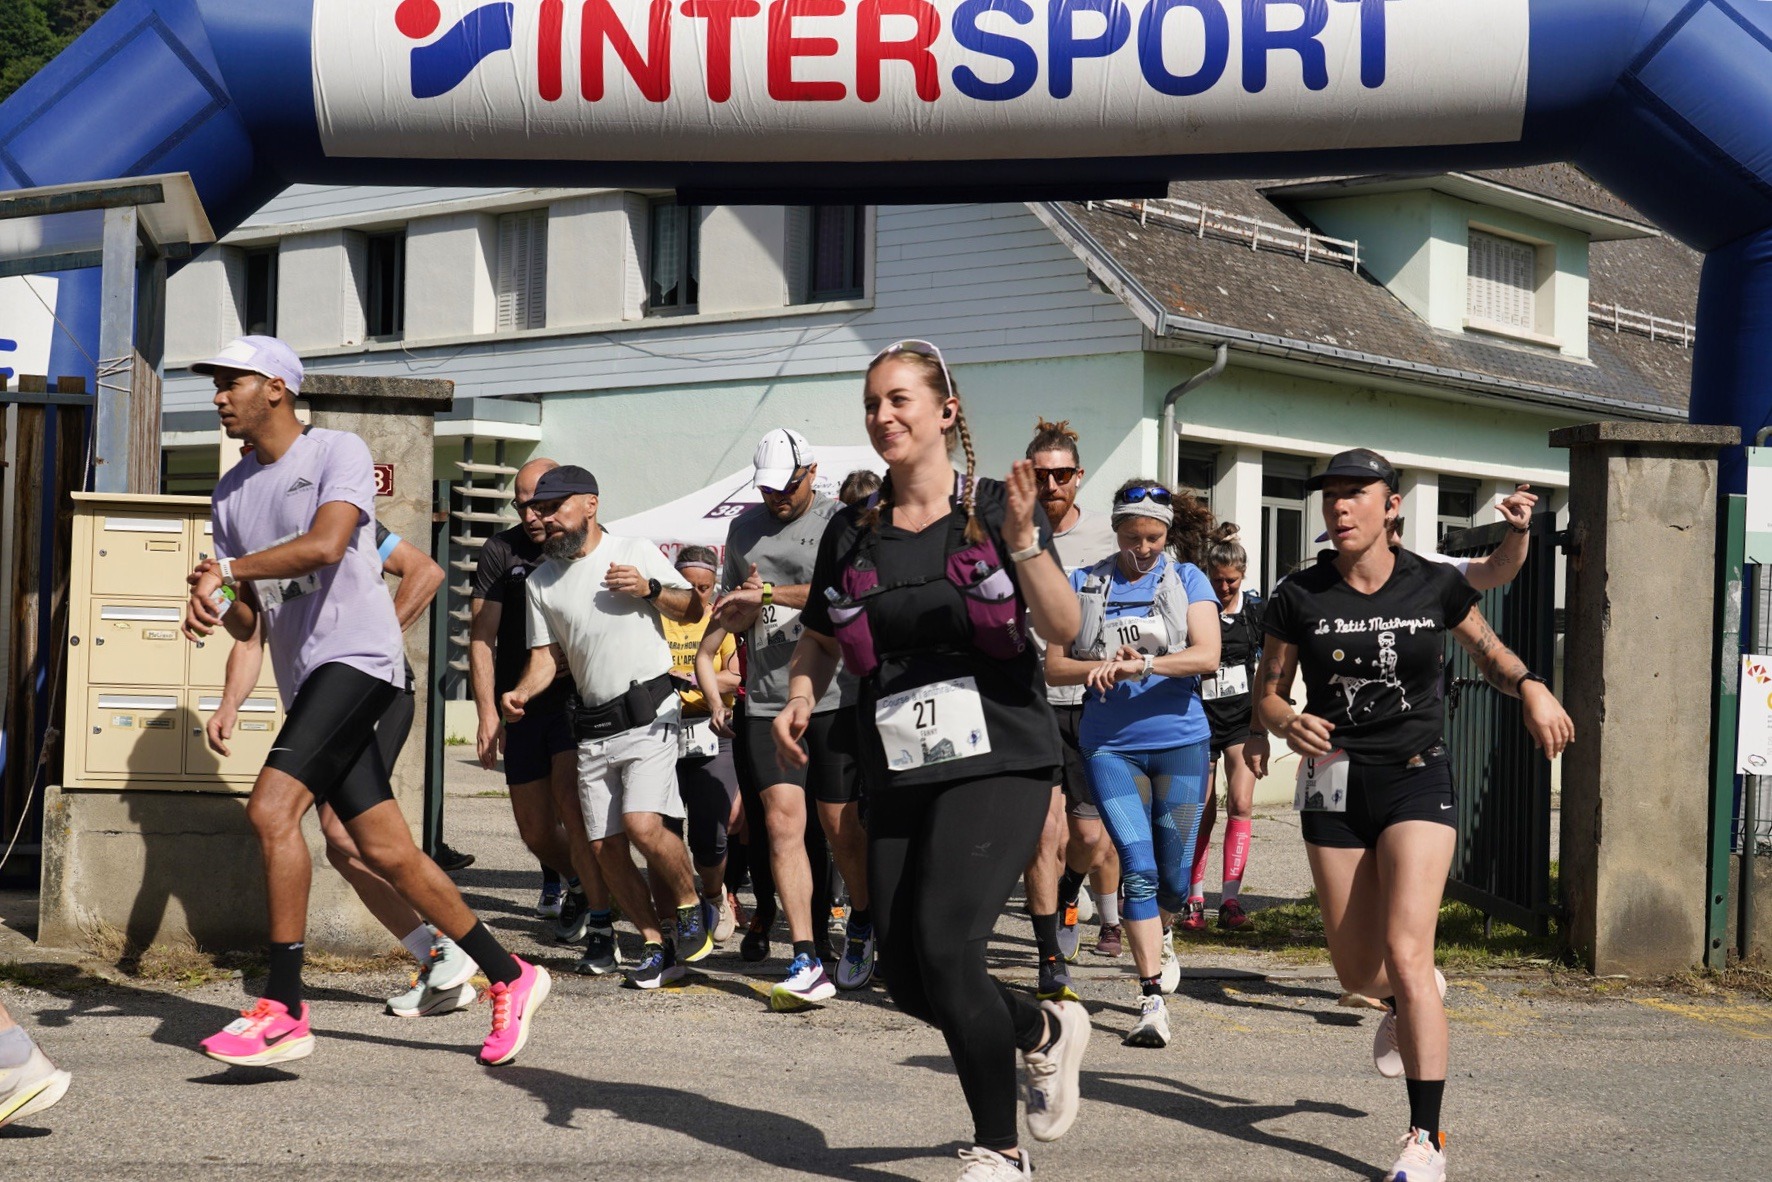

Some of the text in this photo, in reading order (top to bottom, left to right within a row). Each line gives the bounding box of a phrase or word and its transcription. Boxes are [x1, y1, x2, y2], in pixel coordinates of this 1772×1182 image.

[537, 0, 1390, 103] INTERSPORT
[710, 505, 745, 517] 38
[762, 605, 777, 624] 32
[1117, 625, 1140, 645] 110
[1314, 618, 1331, 635] Le
[1334, 618, 1367, 633] Petit
[913, 699, 936, 729] 27
[1307, 757, 1315, 779] 9
